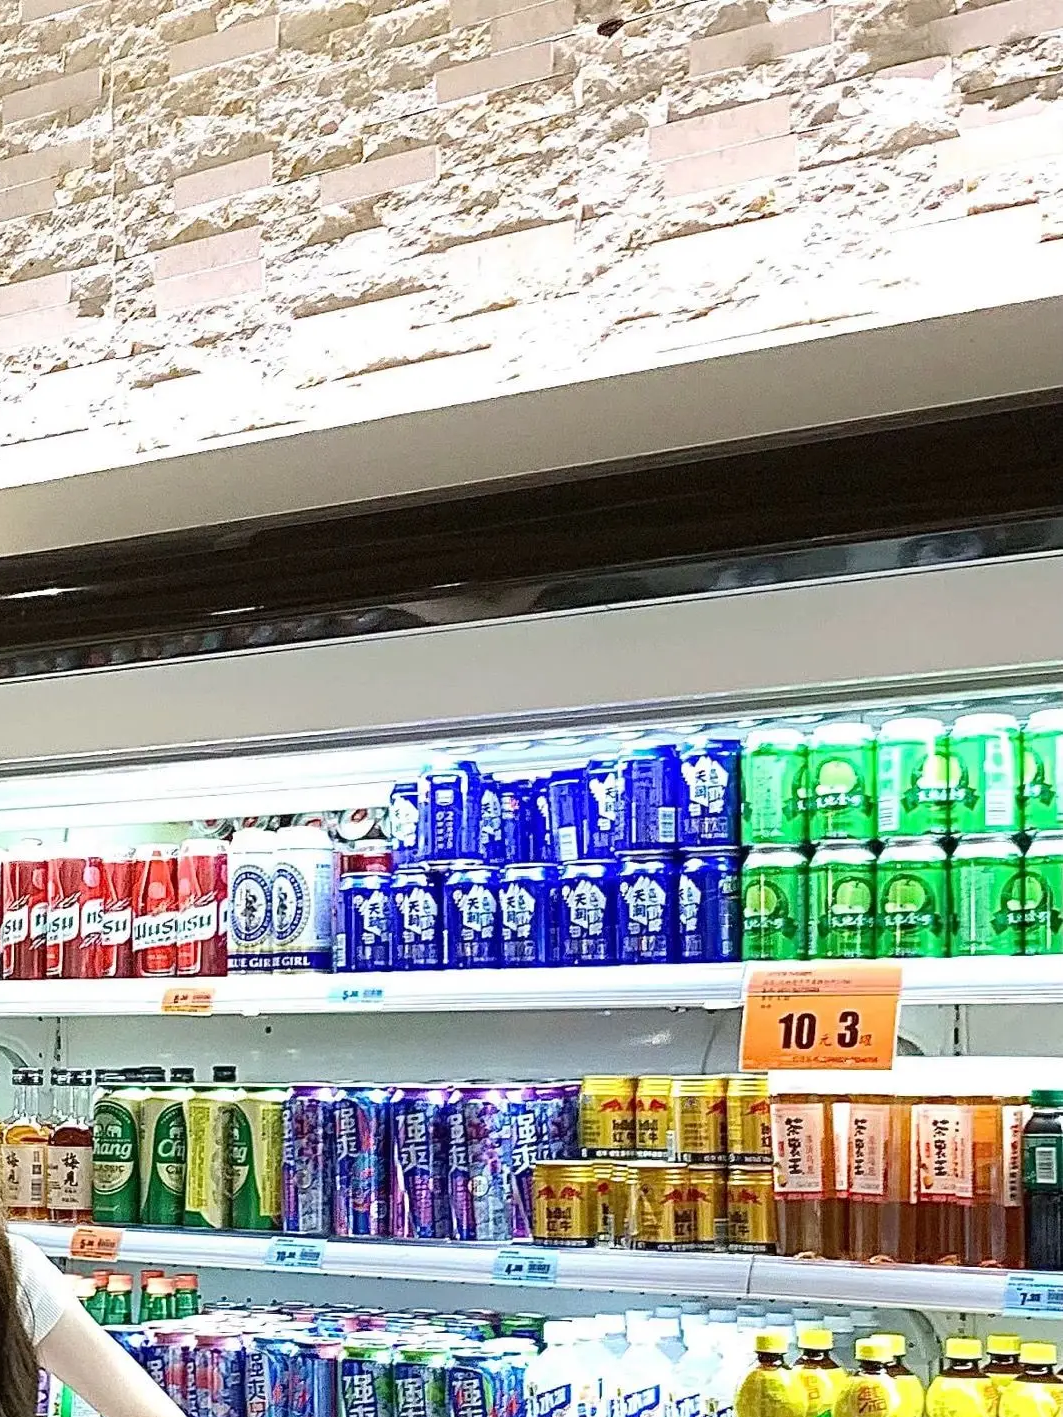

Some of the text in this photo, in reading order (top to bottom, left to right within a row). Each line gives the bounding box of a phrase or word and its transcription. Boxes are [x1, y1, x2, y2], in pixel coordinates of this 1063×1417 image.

[281, 956, 311, 968] GIRL
[778, 1012, 817, 1050] 10
[837, 1010, 860, 1049] 3
